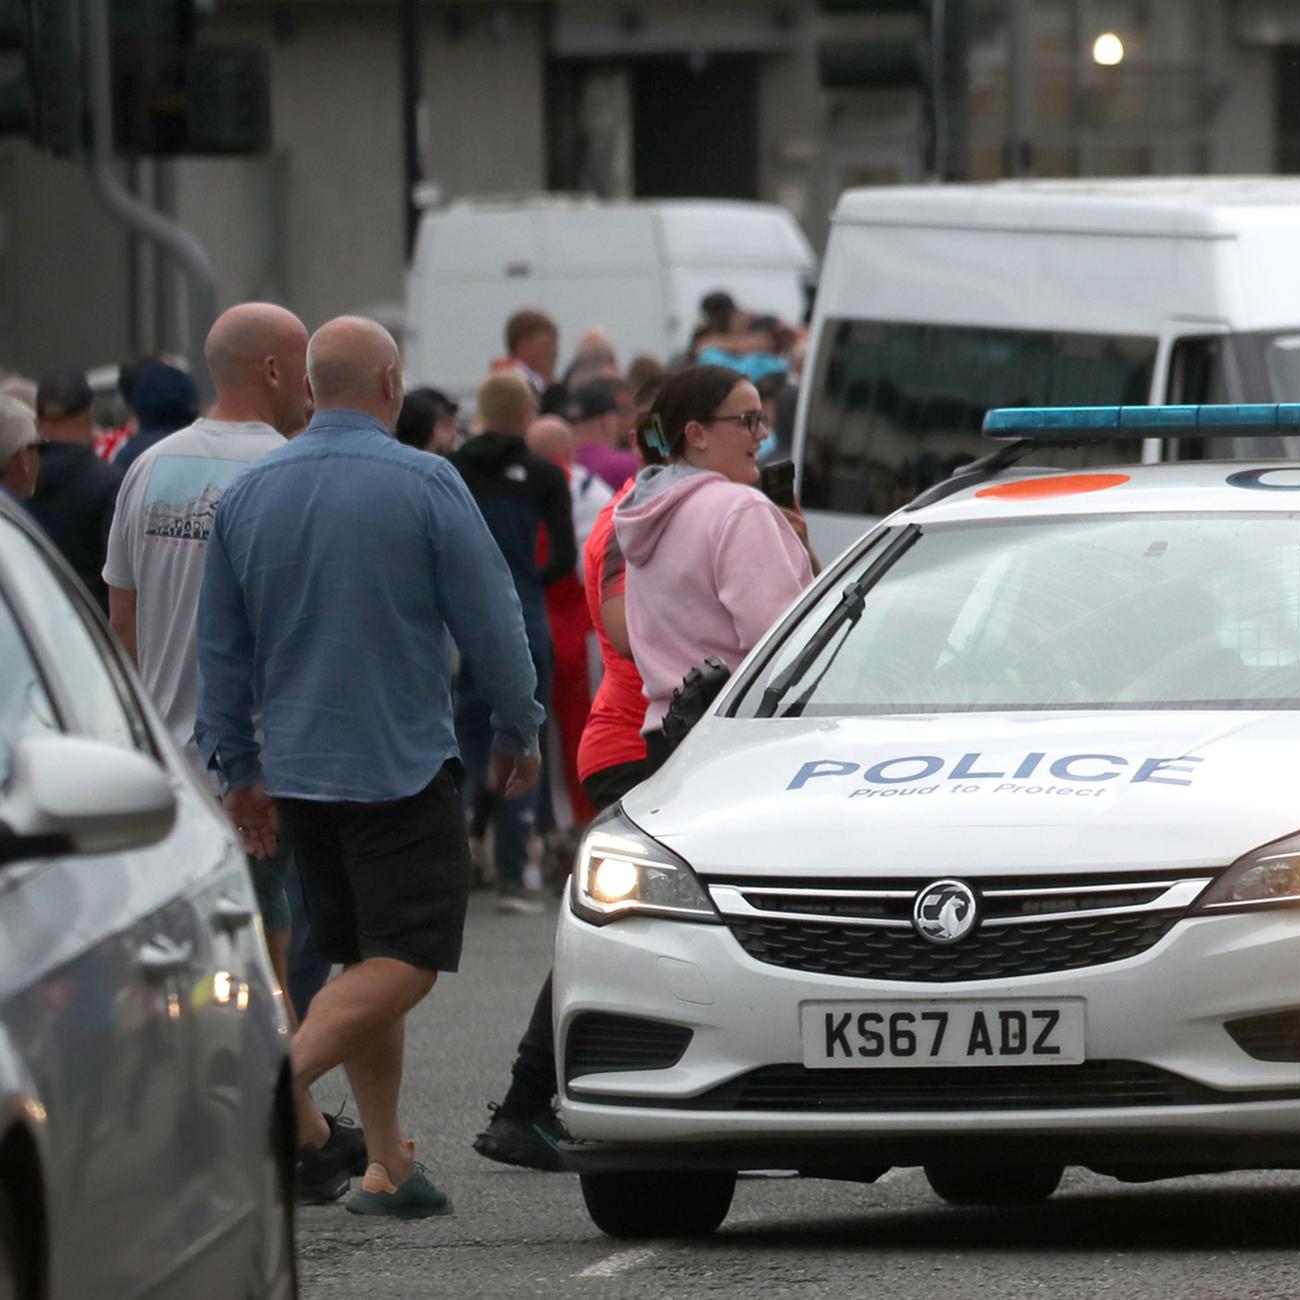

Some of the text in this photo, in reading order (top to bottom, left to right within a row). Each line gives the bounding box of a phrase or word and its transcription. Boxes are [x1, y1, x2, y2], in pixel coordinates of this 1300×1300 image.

[786, 752, 1205, 791] POLICE
[848, 783, 1107, 799] Proud to Protect
[825, 1009, 1061, 1058] KS67 ADZ
